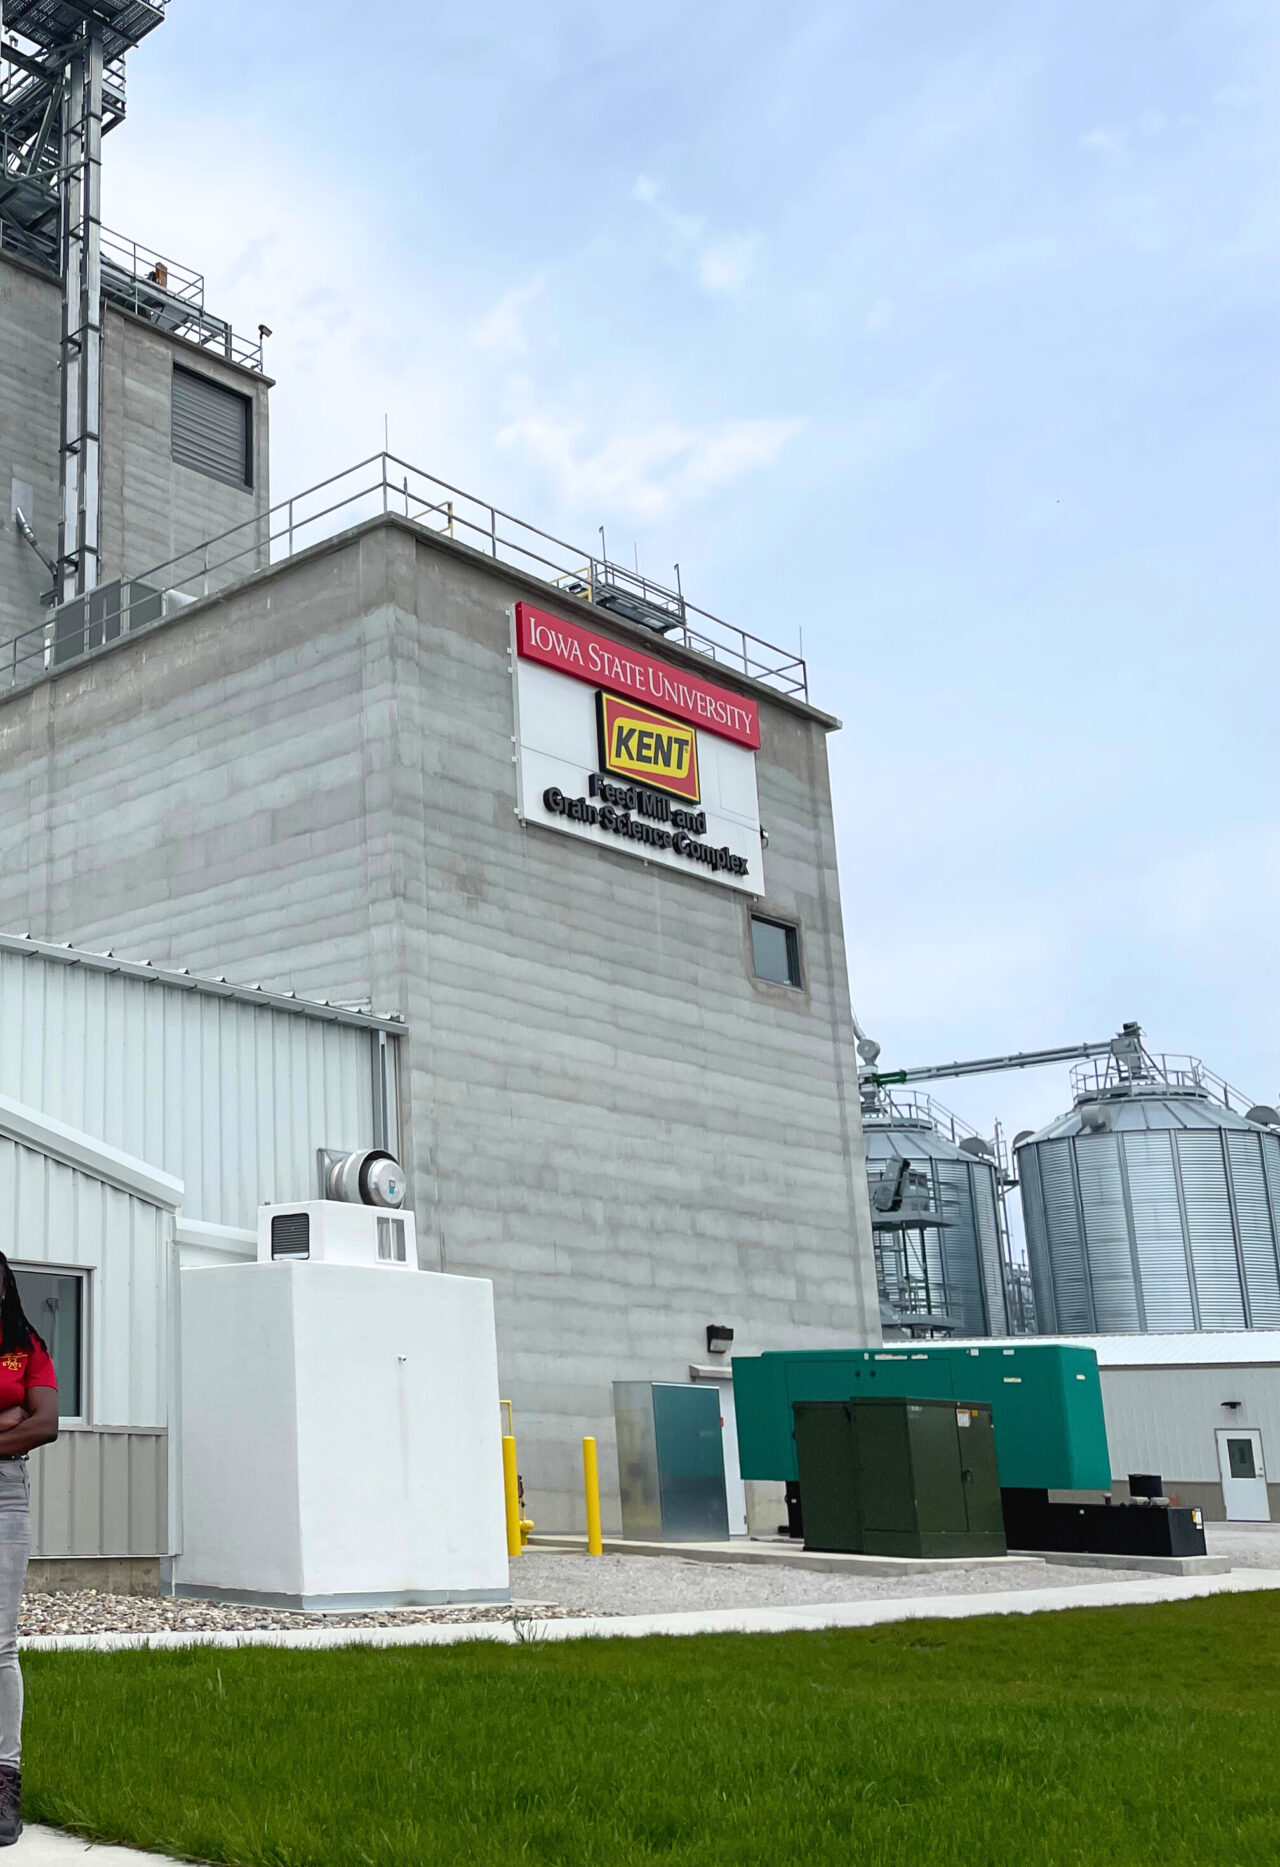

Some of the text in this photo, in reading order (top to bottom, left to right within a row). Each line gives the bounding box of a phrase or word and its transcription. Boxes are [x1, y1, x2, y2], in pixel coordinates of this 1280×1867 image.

[529, 617, 753, 735] IOWA STATE UNIVERSITY
[615, 724, 690, 770] KENT
[543, 787, 749, 875] Grain Science Complex
[588, 772, 707, 834] Feed Mill and
